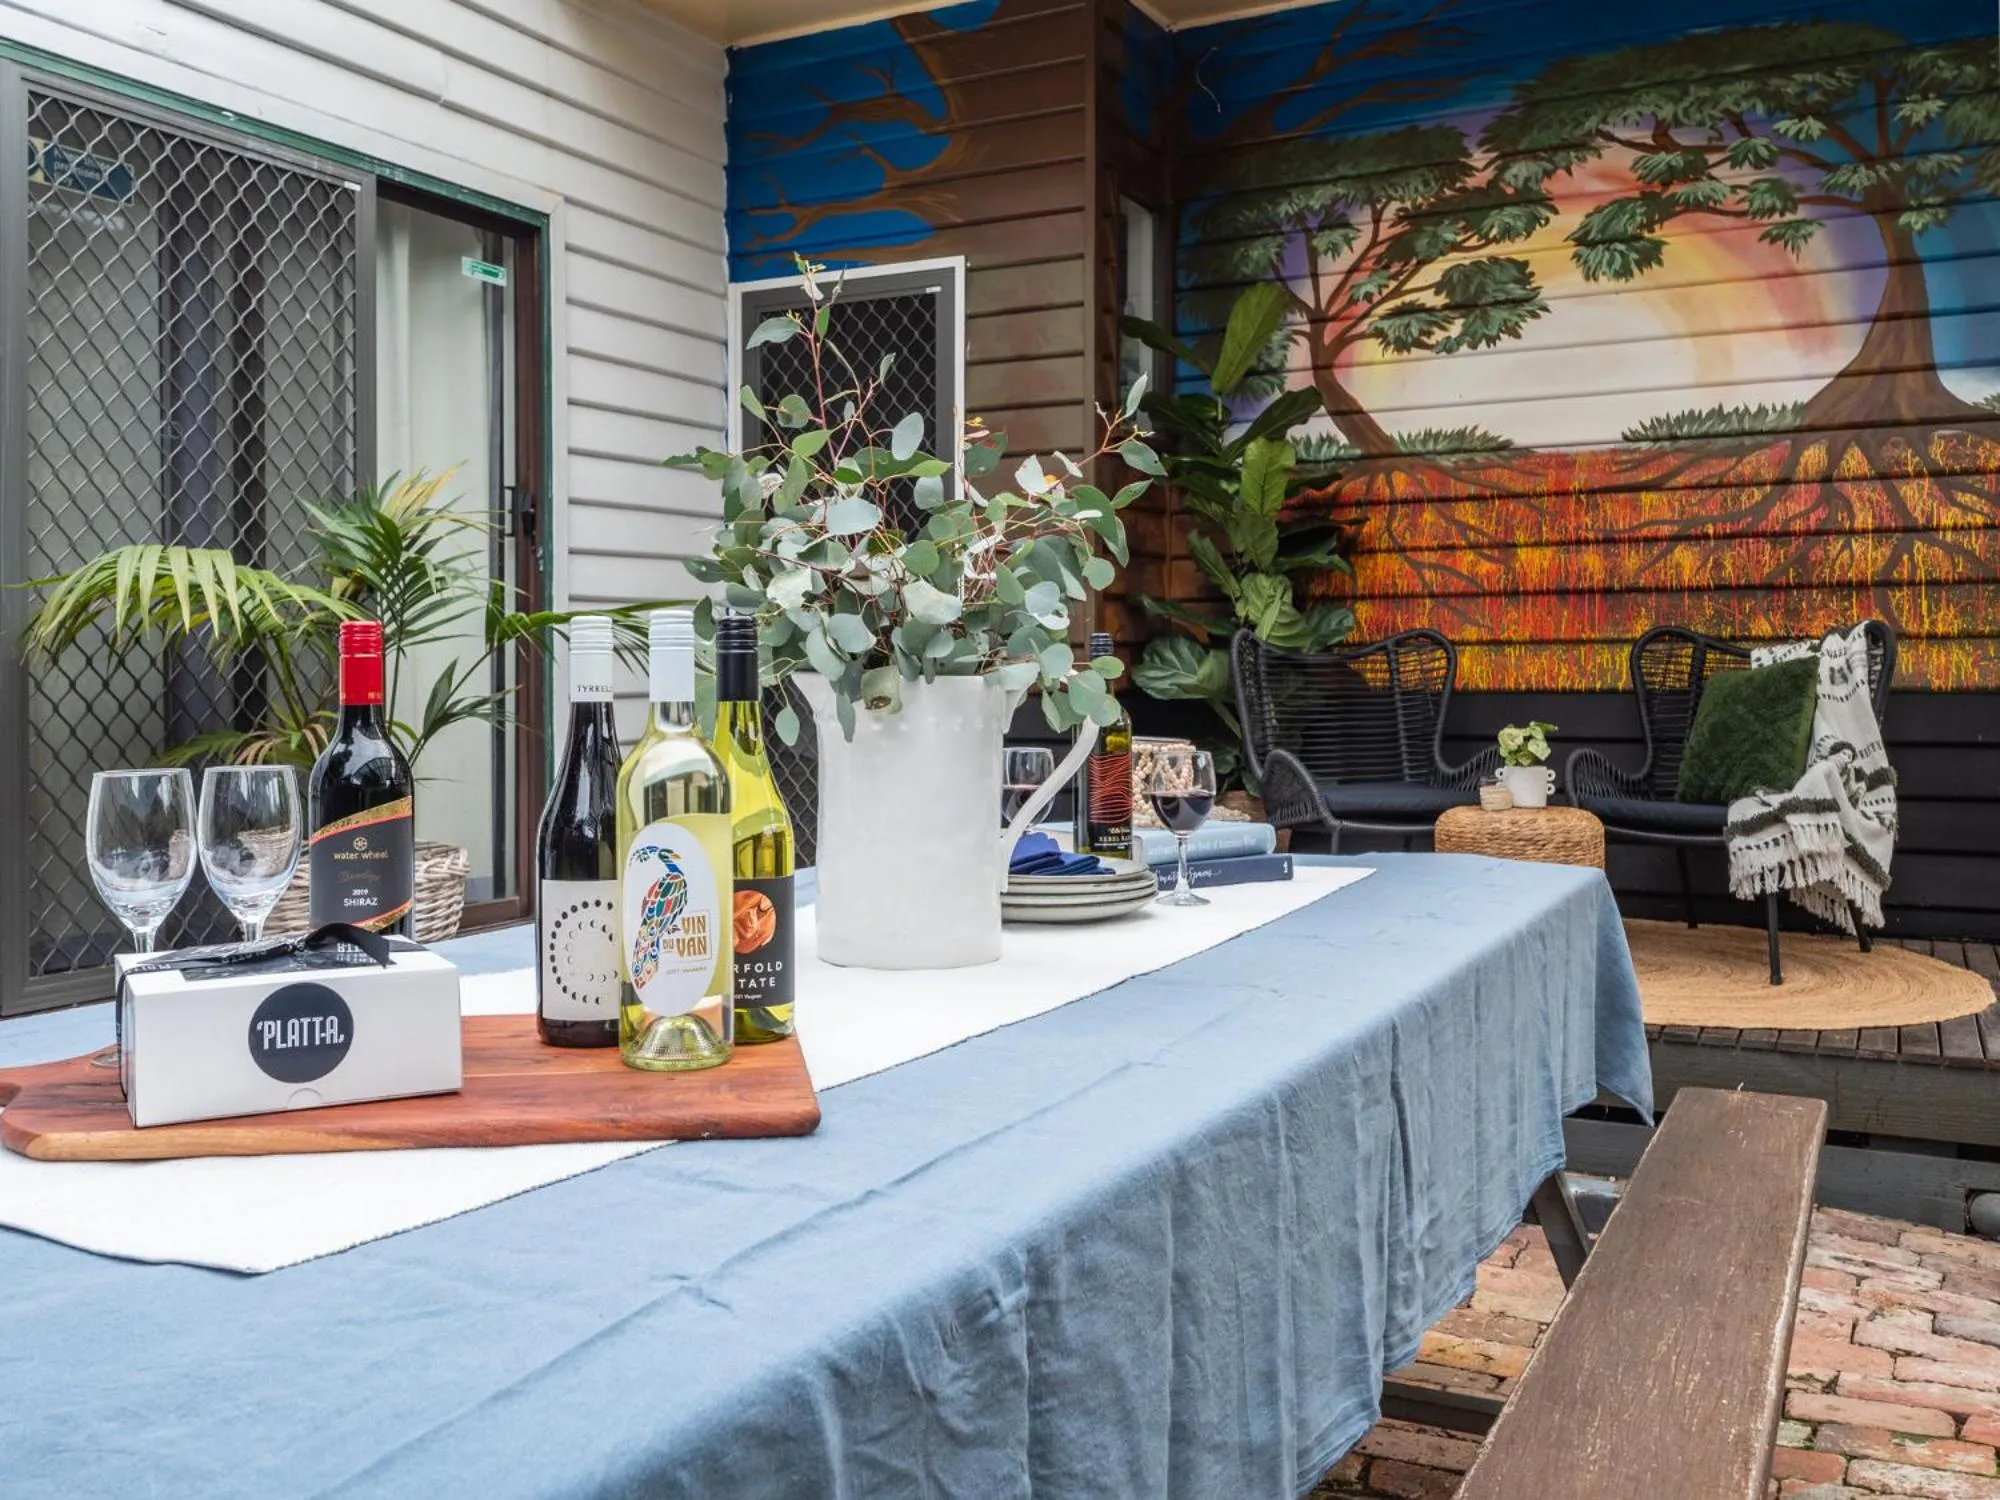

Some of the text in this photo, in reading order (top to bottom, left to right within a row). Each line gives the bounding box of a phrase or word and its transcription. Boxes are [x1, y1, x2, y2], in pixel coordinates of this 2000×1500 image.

[333, 849, 389, 860] water wheel
[352, 888, 369, 896] 2019
[343, 897, 379, 908] SHIRAZ
[681, 915, 706, 935] VIN
[676, 935, 707, 958] VAN
[733, 961, 783, 974] RFOLD
[738, 976, 777, 989] TATE
